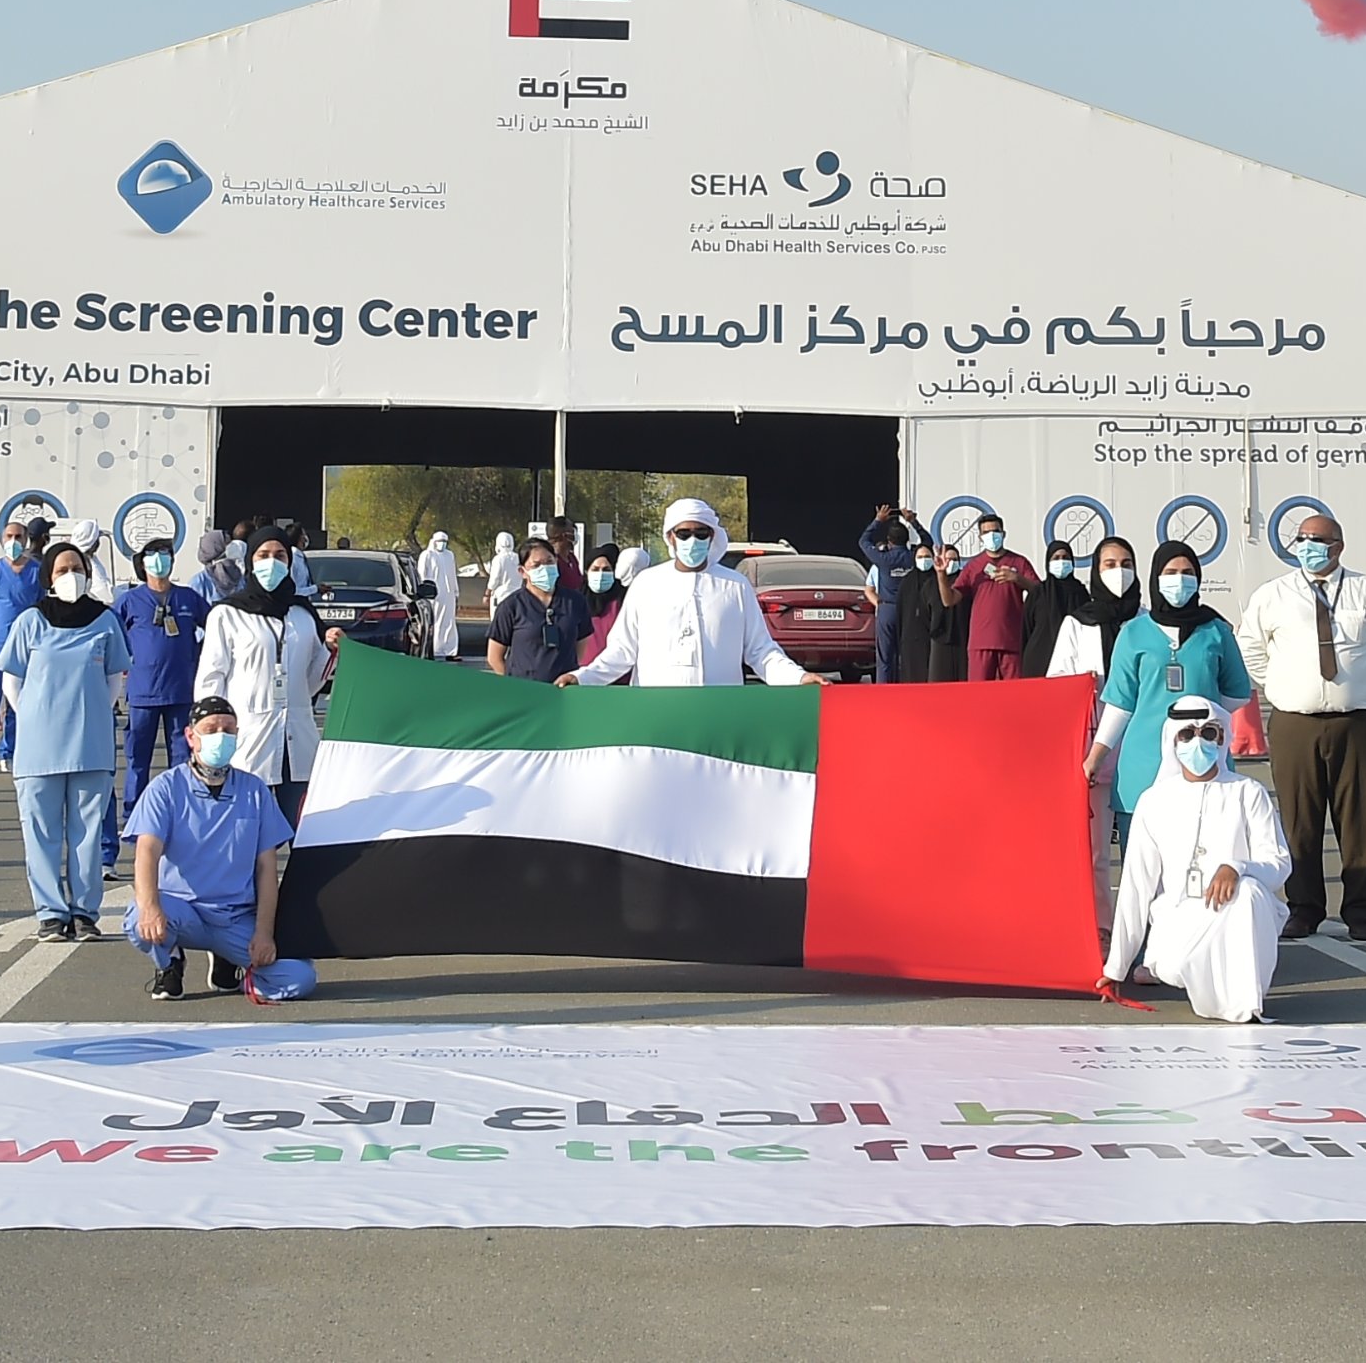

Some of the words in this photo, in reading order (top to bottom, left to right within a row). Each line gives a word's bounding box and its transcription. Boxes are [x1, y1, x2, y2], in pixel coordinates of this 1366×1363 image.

[496, 114, 525, 132] زايد
[529, 115, 547, 132] بن
[552, 117, 599, 129] محمد
[603, 113, 648, 134] الشيخ
[222, 174, 292, 191] الخارجية
[296, 178, 368, 194] العلاجية
[371, 180, 447, 195] الخدمات
[691, 174, 768, 196] SEHA
[870, 171, 946, 197] صحة
[222, 193, 305, 210] Ambulatory
[309, 196, 385, 209] Healthcare
[389, 197, 446, 210] Services
[721, 213, 773, 236] الصحية
[778, 213, 840, 230] للخدمات
[844, 209, 901, 239] أبوظبي
[905, 214, 946, 234] شركة
[691, 239, 721, 252] Abu
[725, 239, 769, 253] Dhabi
[773, 240, 822, 254] Health
[826, 241, 891, 254] Services
[895, 241, 919, 255] Co.
[922, 245, 947, 255] PJSC
[73, 292, 344, 346] Screening
[358, 298, 538, 340] Center
[611, 303, 783, 352] المسح
[799, 304, 930, 354] مركز
[1045, 306, 1167, 355] بكم
[1180, 298, 1327, 358] مرحباً
[943, 305, 1031, 366] في
[63, 362, 119, 384] Abu
[129, 364, 211, 385] Dhabi
[918, 368, 1014, 404] أبوظبي
[1125, 373, 1167, 401] زايد
[1175, 373, 1251, 402] مدينة
[1094, 444, 1148, 467] Stop
[1154, 444, 1192, 463] the
[1199, 444, 1279, 468] spread
[1285, 445, 1308, 464] of
[1058, 1045, 1207, 1053] SEHA
[102, 1095, 436, 1131] الأول
[485, 1099, 893, 1131] الدفاع
[941, 1101, 1199, 1126] خط
[262, 1143, 511, 1162] are
[556, 1140, 811, 1162] the
